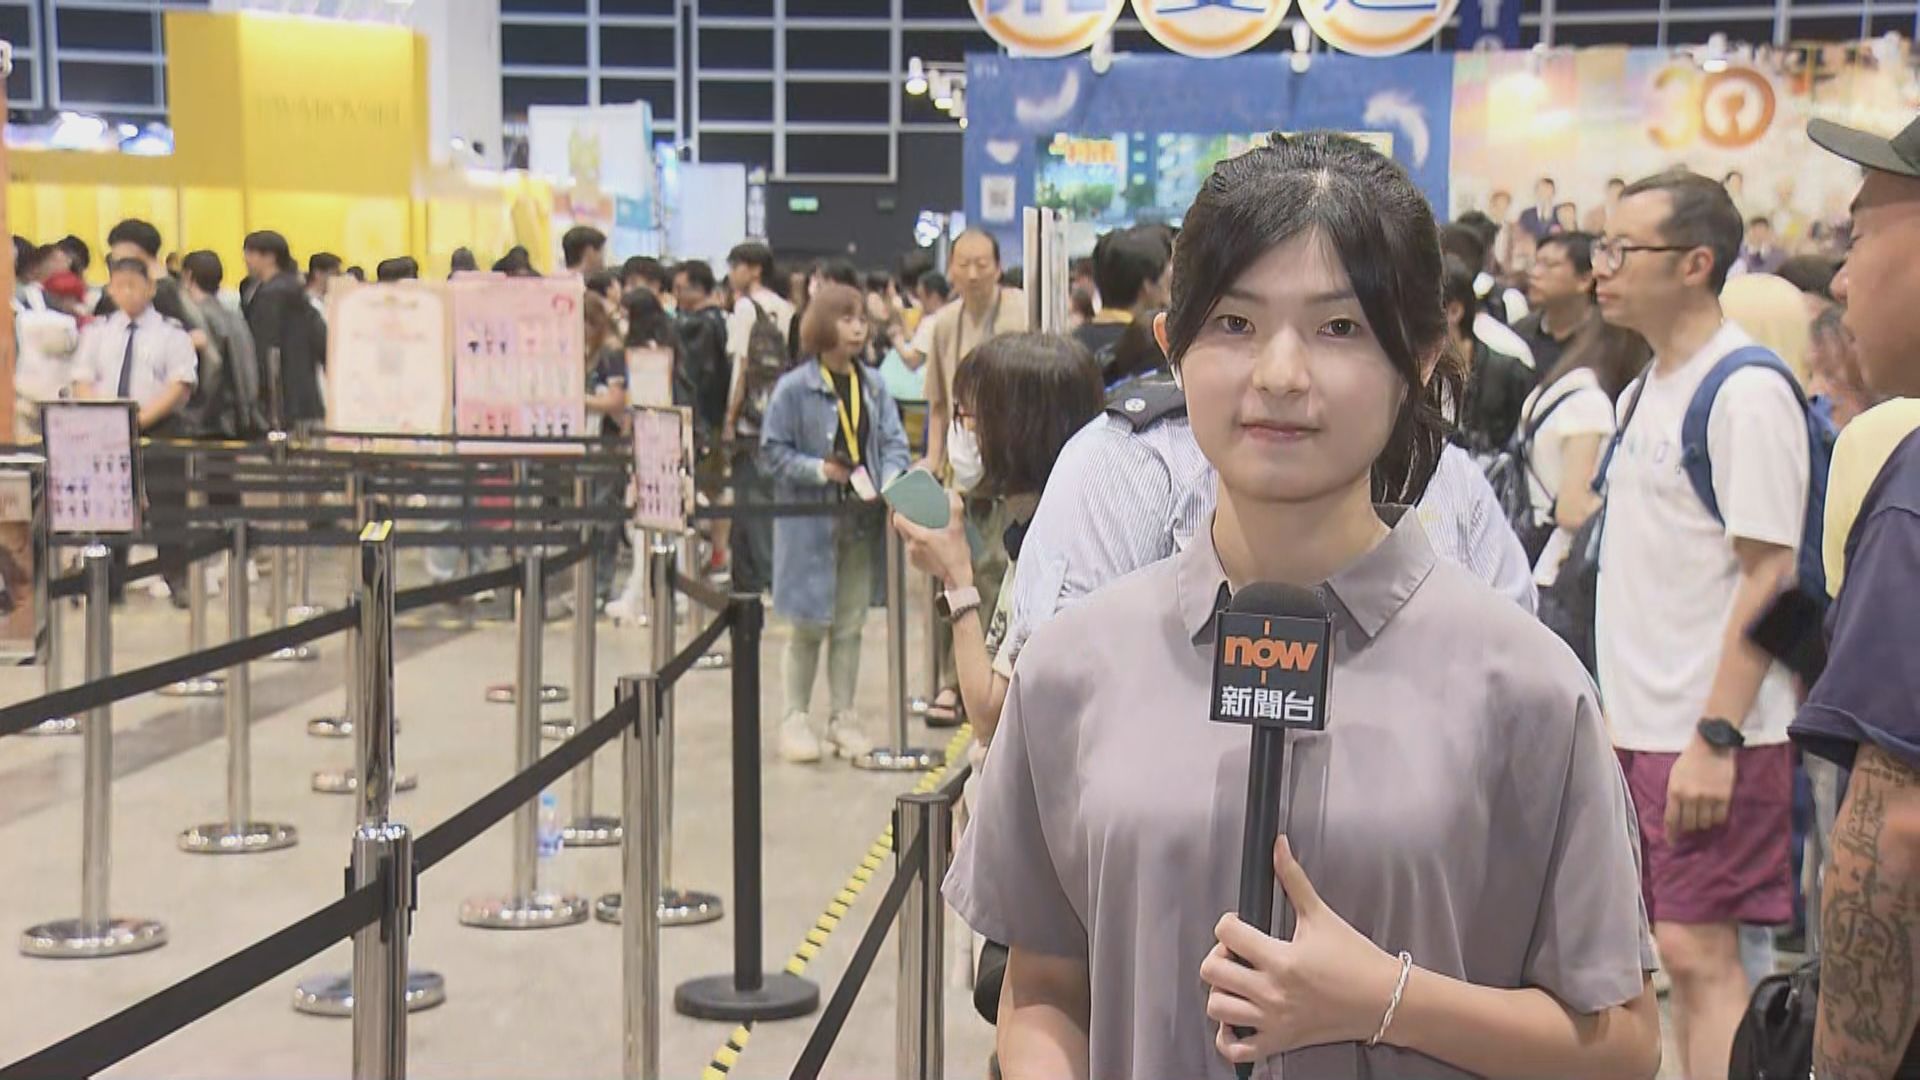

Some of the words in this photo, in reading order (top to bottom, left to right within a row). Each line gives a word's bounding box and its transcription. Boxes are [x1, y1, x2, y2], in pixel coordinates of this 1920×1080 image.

[1224, 635, 1319, 672] now
[1220, 685, 1315, 722] 新聞台
